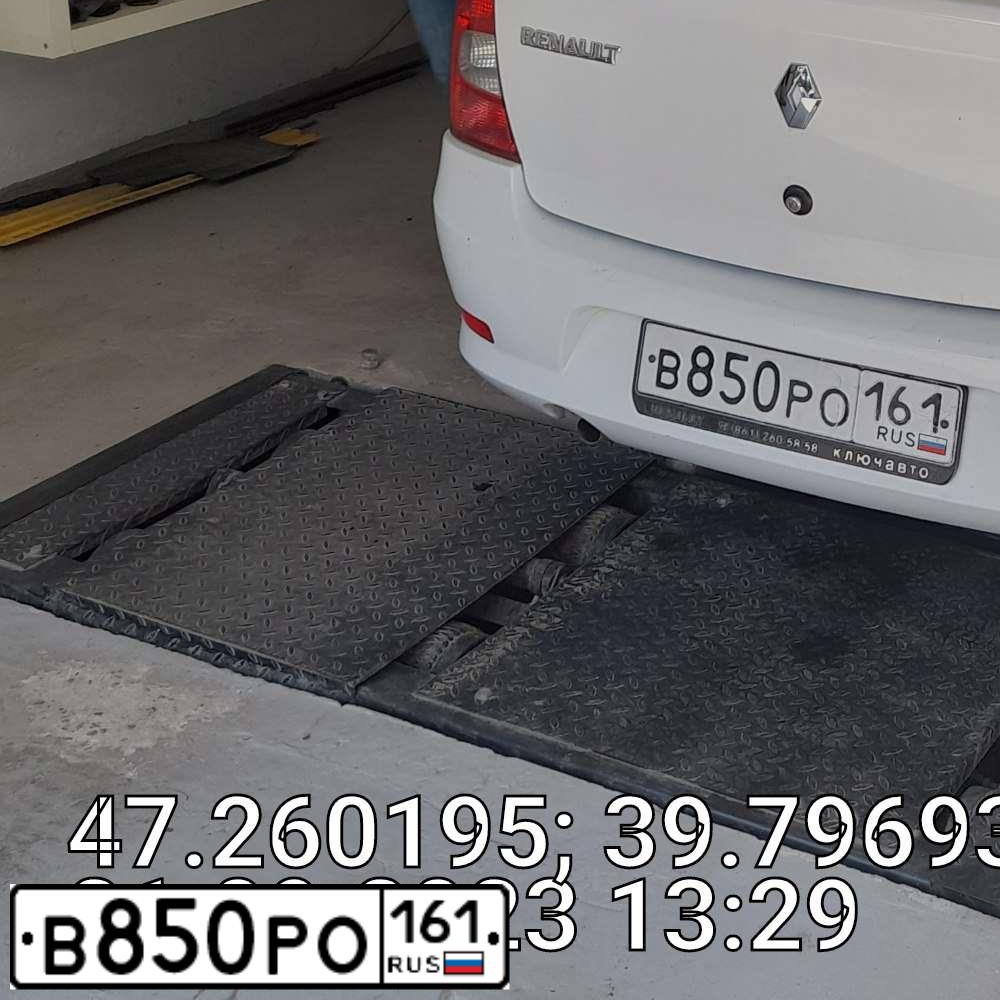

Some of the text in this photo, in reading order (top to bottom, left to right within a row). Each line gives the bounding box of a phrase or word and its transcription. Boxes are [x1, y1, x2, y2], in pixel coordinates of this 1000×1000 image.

[520, 26, 622, 65] RENAULT
[864, 381, 943, 433] 161
[876, 426, 916, 448] RUS
